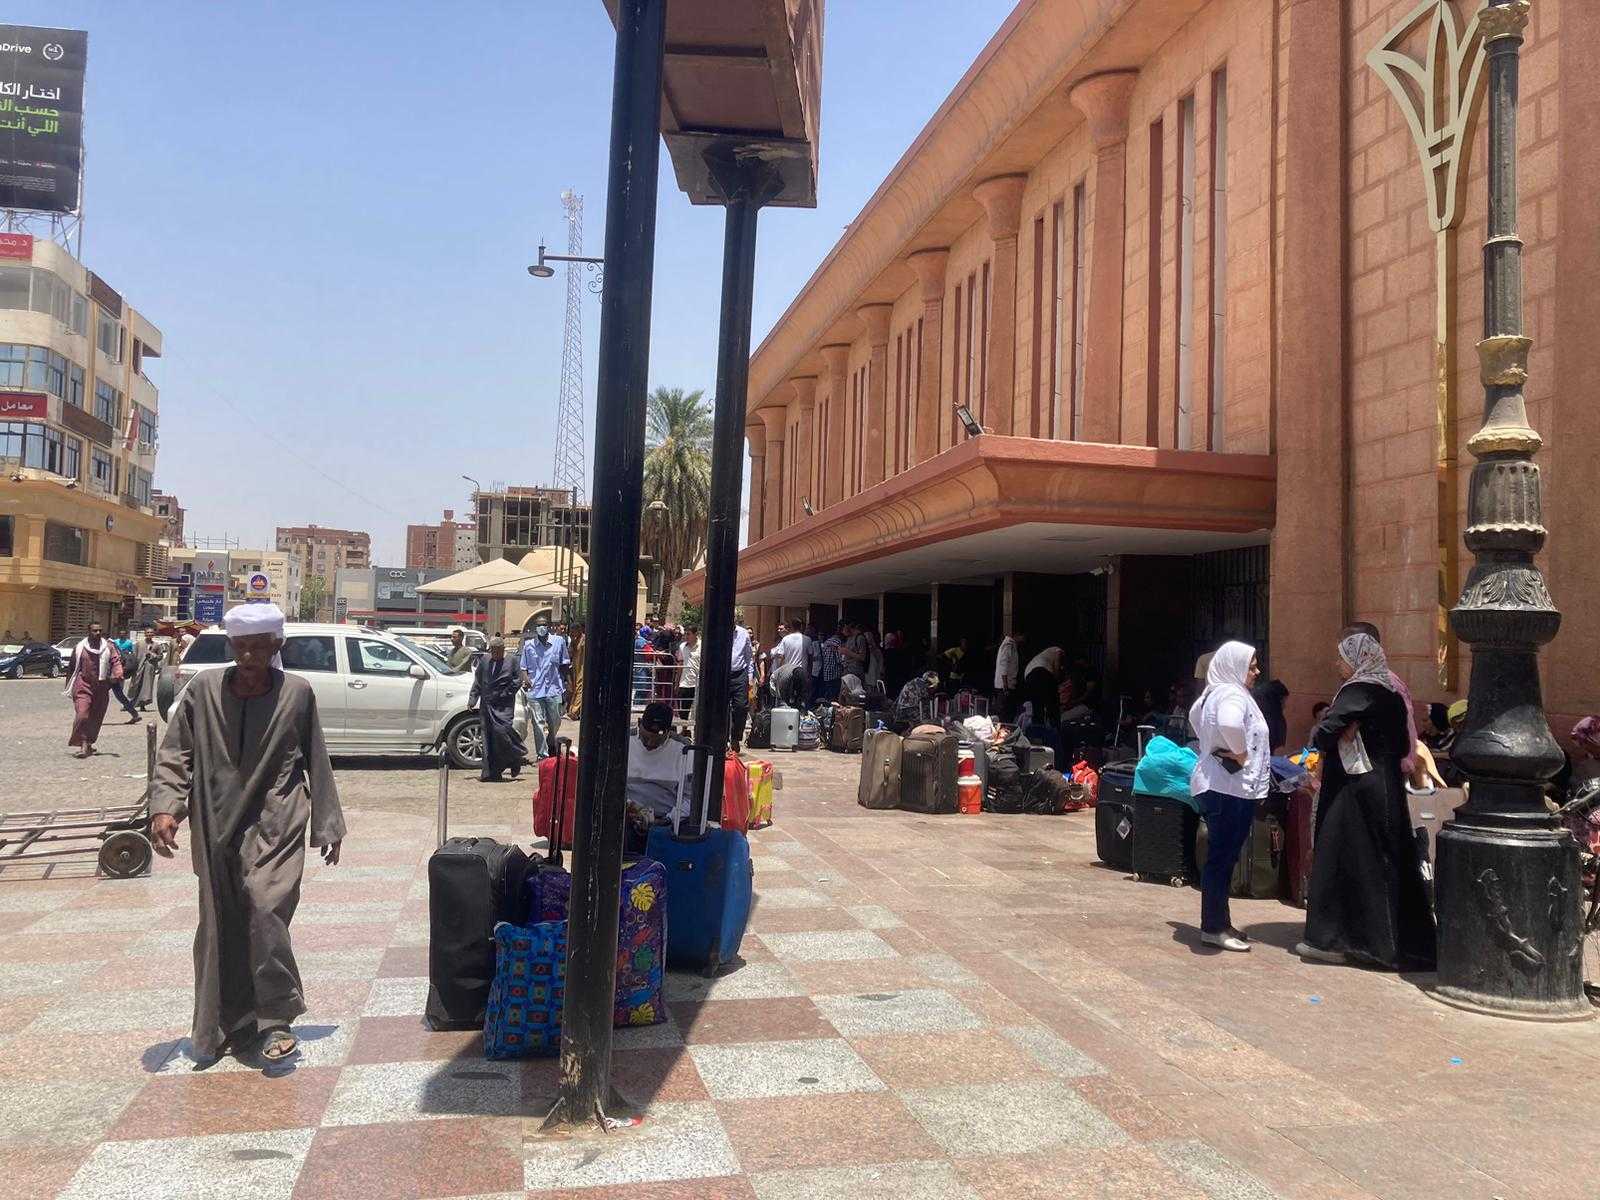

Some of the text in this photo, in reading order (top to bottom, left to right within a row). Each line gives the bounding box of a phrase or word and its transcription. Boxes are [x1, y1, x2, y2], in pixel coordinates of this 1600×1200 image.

[0, 43, 32, 54] Drive
[22, 84, 60, 100] اختار
[14, 105, 59, 117] حسب
[27, 119, 59, 137] اللي
[1, 401, 33, 412] معامل
